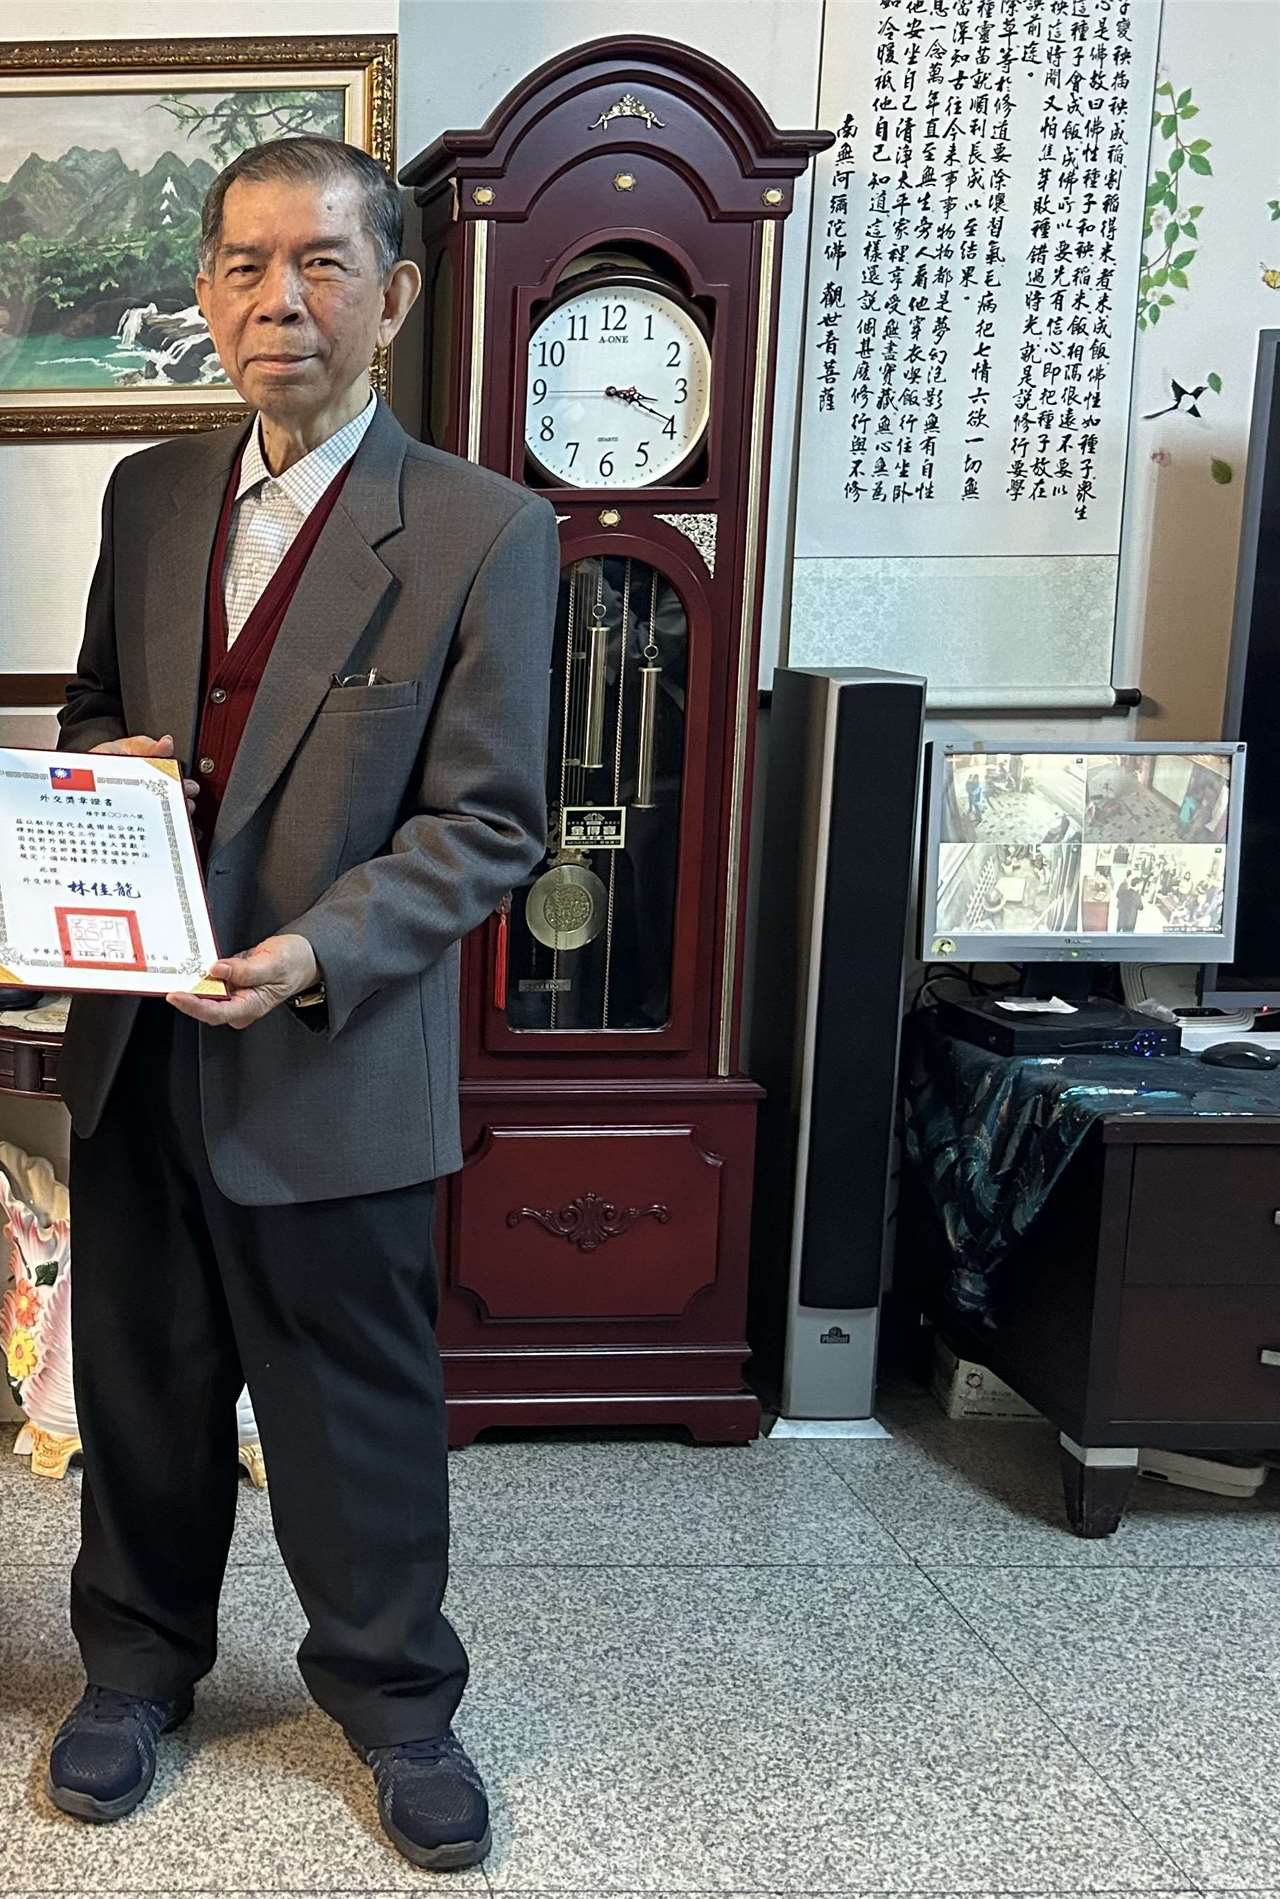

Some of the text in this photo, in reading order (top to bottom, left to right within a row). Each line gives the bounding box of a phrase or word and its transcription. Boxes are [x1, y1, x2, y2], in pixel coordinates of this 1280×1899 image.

[567, 315, 589, 341] 11
[600, 304, 628, 331] 12
[643, 314, 655, 340] 1
[598, 335, 629, 344] A-ONE
[537, 341, 565, 367] 10
[666, 341, 681, 367] 2
[532, 379, 547, 405] 9
[674, 377, 688, 404] 3
[540, 415, 555, 442] 8
[662, 414, 677, 440] 4
[565, 442, 580, 467] 7
[599, 451, 614, 477] 6
[635, 441, 650, 467] 5
[67, 880, 142, 898] 林佳龍
